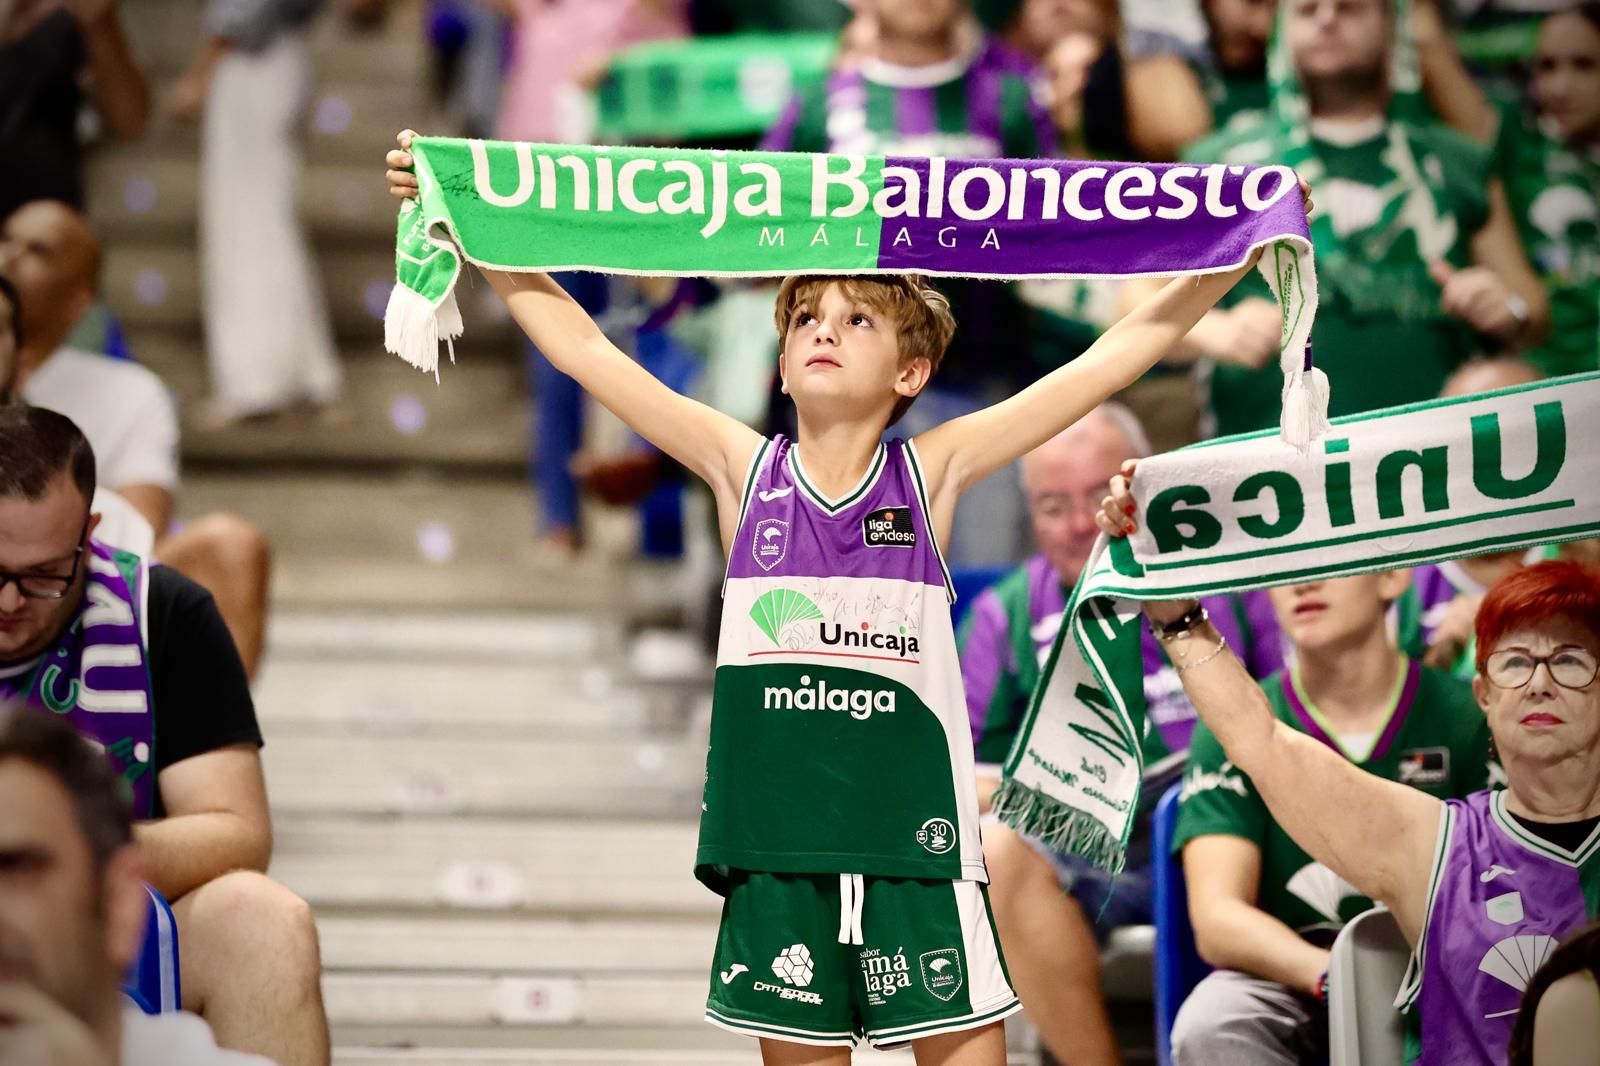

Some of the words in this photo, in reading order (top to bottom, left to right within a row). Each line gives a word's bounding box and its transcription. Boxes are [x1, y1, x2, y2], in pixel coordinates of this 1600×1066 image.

[467, 139, 782, 240] Unicaja
[810, 154, 1298, 222] Baloncesto
[758, 223, 1001, 250] MÁLAGA
[868, 519, 893, 532] liga
[870, 529, 915, 542] endesa
[819, 621, 920, 658] Unicaja
[930, 823, 947, 837] 30
[859, 947, 881, 959] sabor
